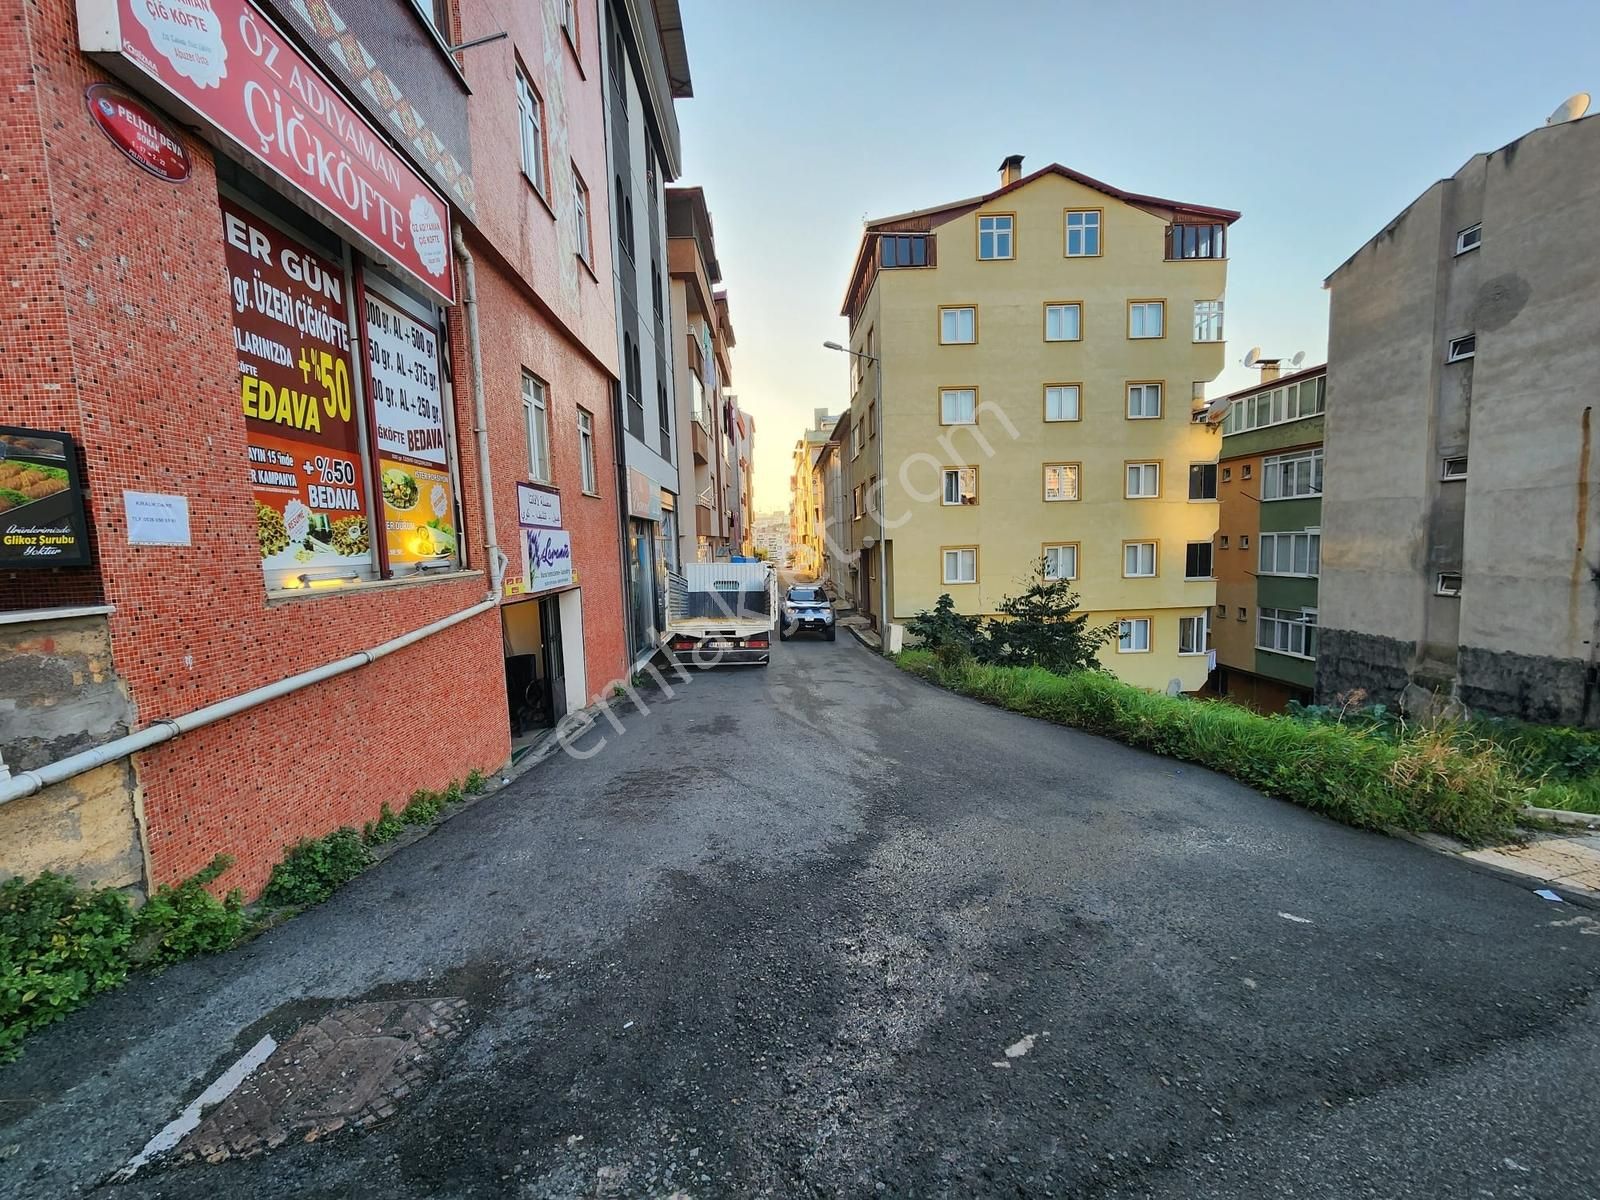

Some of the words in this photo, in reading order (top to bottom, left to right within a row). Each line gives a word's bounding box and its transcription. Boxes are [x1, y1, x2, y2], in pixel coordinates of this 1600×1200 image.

[239, 7, 282, 80] ÖZ
[289, 65, 401, 192] ADIYAMAN
[117, 104, 158, 140] PELİTLİ
[159, 132, 183, 158] DEVA
[244, 80, 405, 250] ÇİĞKÖFTE
[225, 211, 274, 267] ER
[280, 249, 342, 304] GÜN
[233, 276, 253, 313] gr.
[253, 268, 295, 327] ÜZERİ
[295, 293, 350, 352] ÇİĞKÖFTE
[393, 315, 403, 340] AL
[369, 337, 380, 364] 50
[396, 351, 406, 376] AL
[242, 375, 321, 433] EDAVA
[372, 376, 384, 402] 00
[399, 388, 410, 412] AL
[377, 424, 406, 445] ĞKÖFTE
[407, 428, 443, 452] BEDAVA
[258, 469, 298, 487] KAMPANYA
[308, 484, 360, 511] BEDAVA
[3, 535, 38, 545] Glikoz
[38, 534, 75, 546] Şurubu
[23, 545, 62, 556] Yoktur
